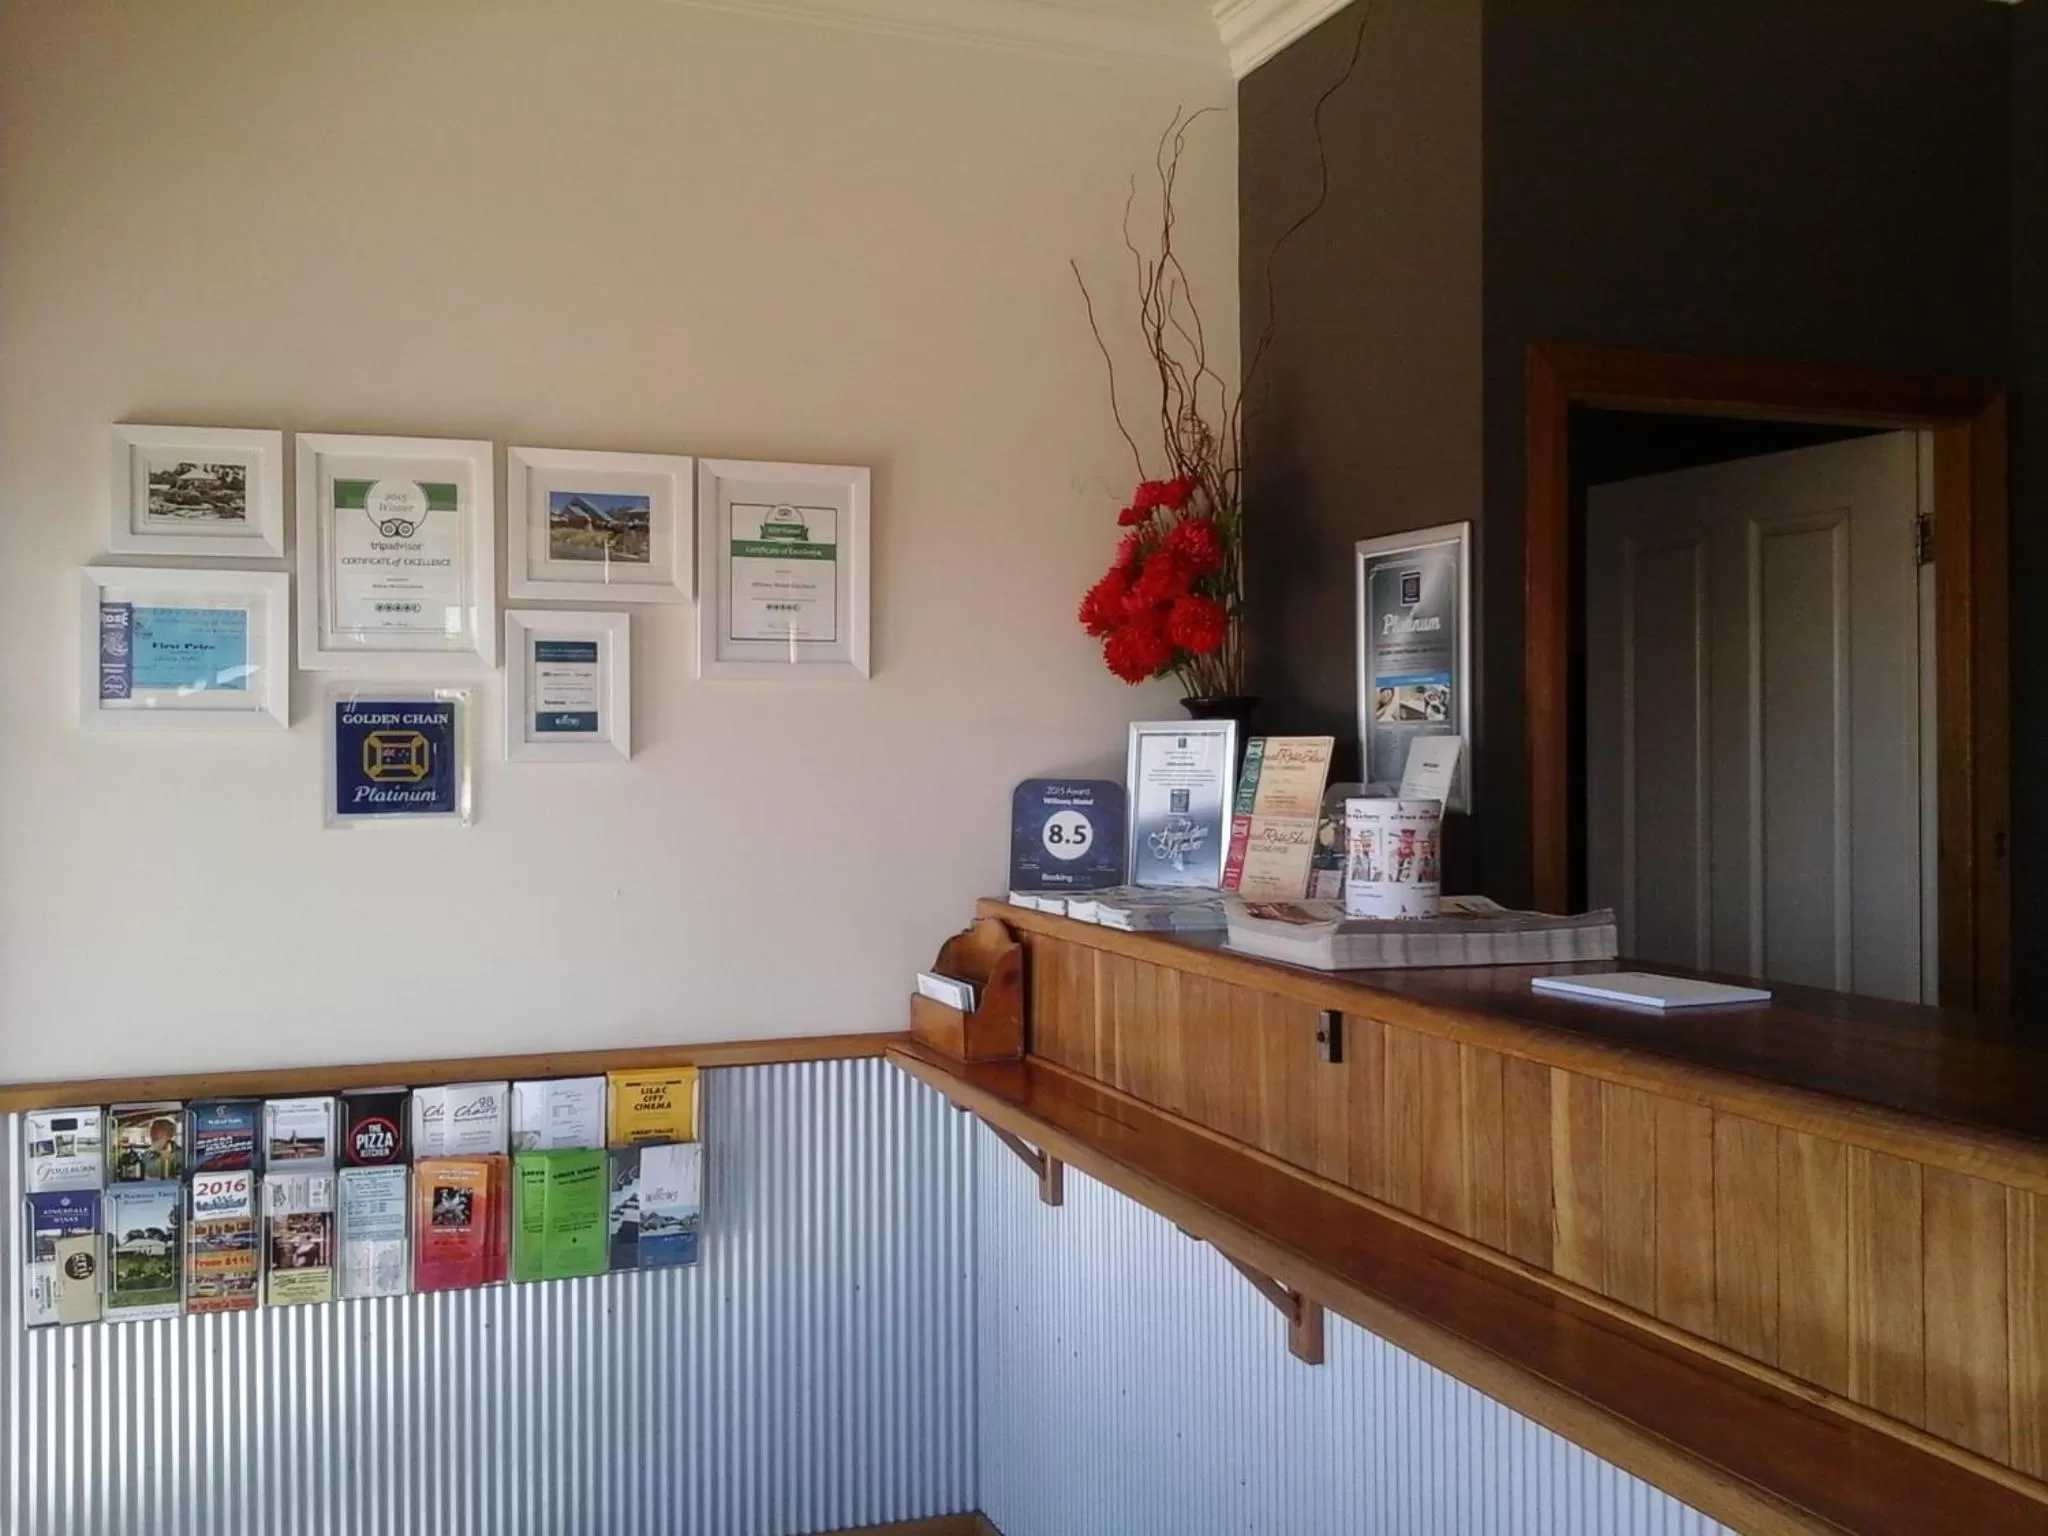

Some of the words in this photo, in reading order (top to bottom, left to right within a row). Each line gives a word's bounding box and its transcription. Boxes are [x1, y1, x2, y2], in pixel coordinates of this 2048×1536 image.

[370, 540, 422, 552] tripadvisor
[341, 557, 391, 566] CERTIFICATE
[403, 557, 452, 567] EXCELLENCE
[342, 713, 400, 725] GOLDEN
[402, 713, 449, 725] CHAIN
[351, 784, 438, 804] Platinum
[1066, 786, 1091, 796] Award
[1048, 823, 1087, 845] 8.5
[640, 1086, 668, 1096] LILAC
[643, 1095, 665, 1104] CITY
[633, 1102, 672, 1112] CINEMA
[368, 1123, 382, 1132] THE
[355, 1133, 394, 1150] PIZZA
[195, 1178, 247, 1197] 2016
